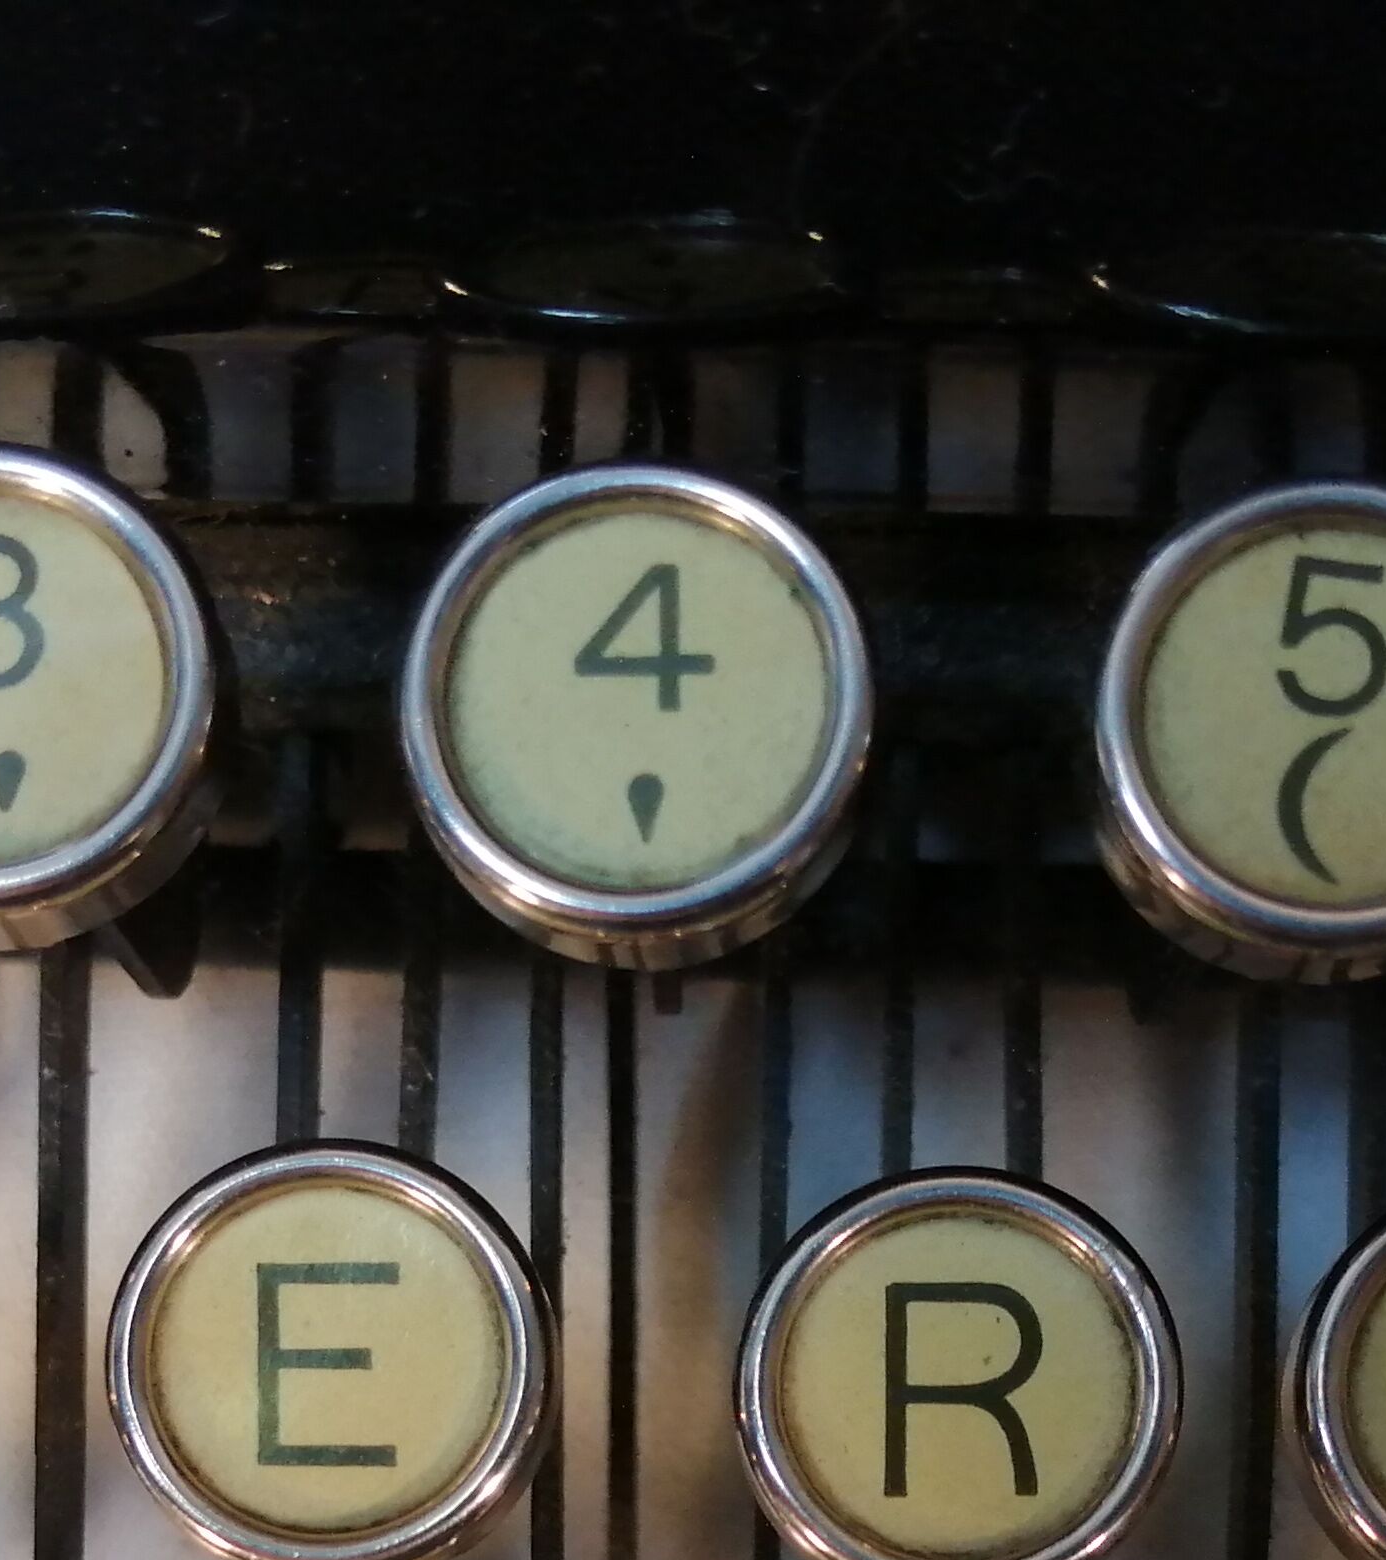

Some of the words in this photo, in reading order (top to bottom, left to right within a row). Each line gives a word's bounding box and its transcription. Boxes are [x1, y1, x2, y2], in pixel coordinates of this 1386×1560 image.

[574, 563, 715, 711] 4
[1275, 727, 1354, 886] (
[256, 1262, 399, 1467] E
[884, 1282, 1043, 1497] R
